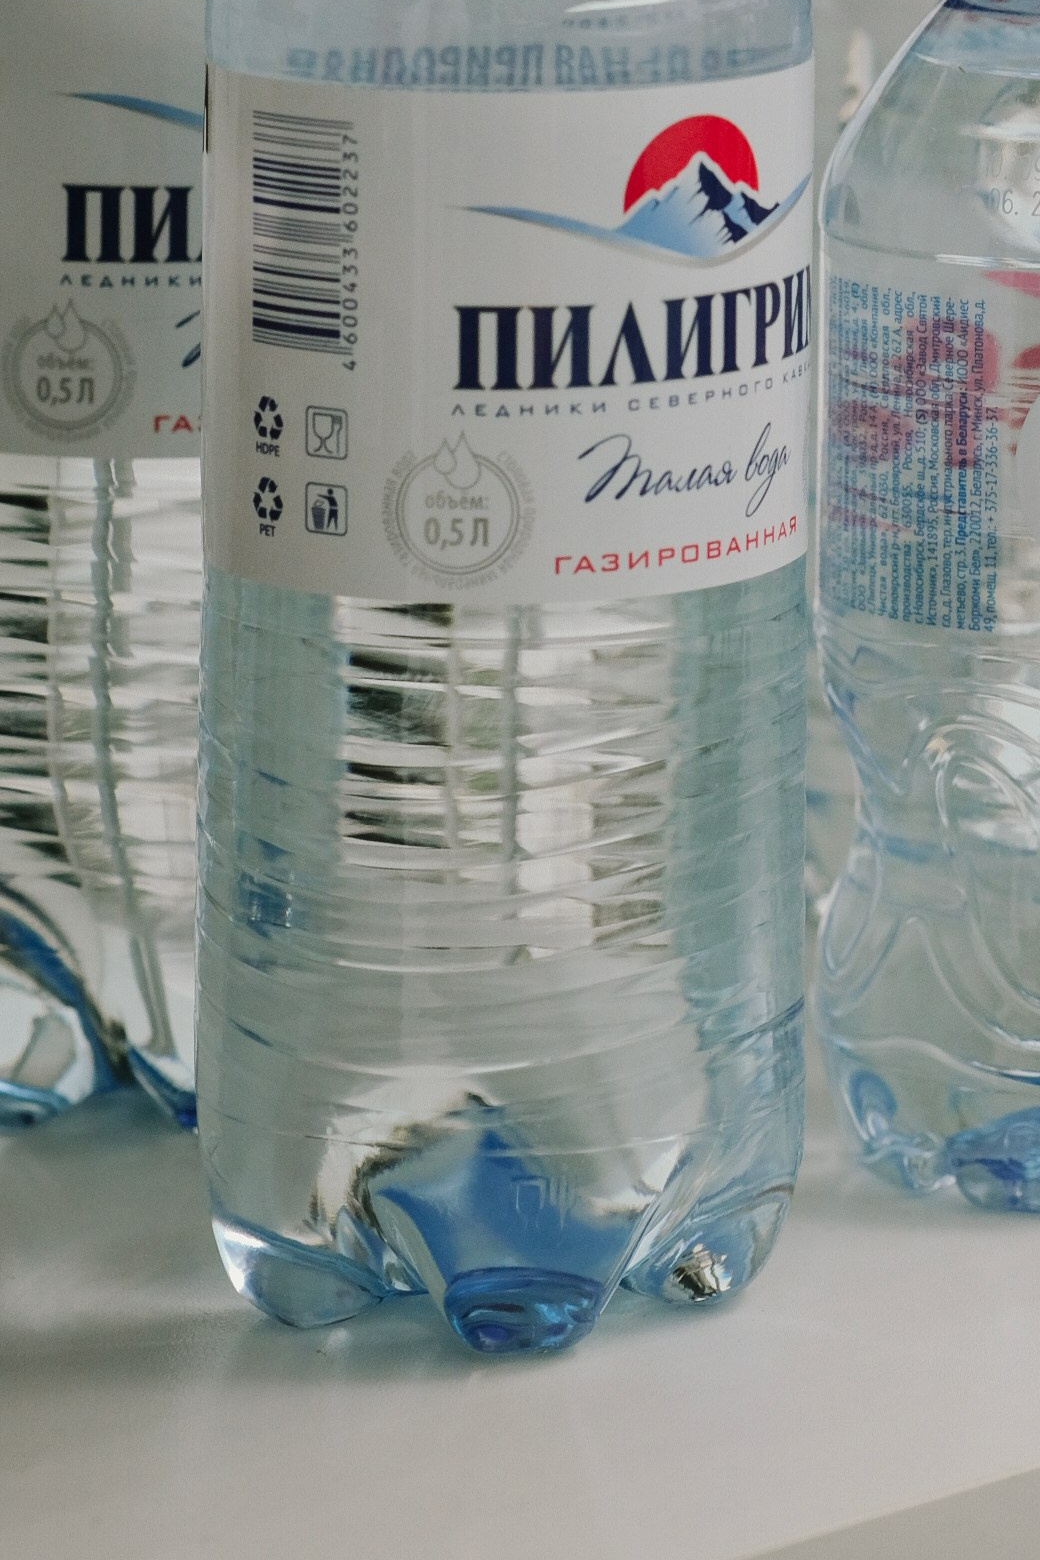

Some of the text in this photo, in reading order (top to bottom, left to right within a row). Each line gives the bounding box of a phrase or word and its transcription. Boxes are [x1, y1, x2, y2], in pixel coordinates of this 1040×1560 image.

[894, 289, 904, 324] адрес
[916, 294, 928, 334] Святой
[943, 296, 957, 334] Шере-
[916, 336, 929, 376] «Завод
[929, 296, 944, 373] Дмитровский
[971, 311, 985, 374] Платонова,
[450, 403, 607, 418] ЛЕДНИКИ
[628, 377, 774, 412] СЕВЕРНОГО
[915, 379, 926, 405] ООО
[944, 394, 956, 427] парка
[971, 393, 984, 432] Минск,
[915, 408, 928, 425] (S)
[928, 403, 940, 470] Московская
[956, 388, 970, 446] Беларуси:
[255, 440, 281, 458] HDPE
[915, 428, 927, 453] 510;
[970, 442, 985, 496] Беларусь,
[927, 472, 939, 514] Россия,
[955, 457, 968, 545] Представитель
[259, 523, 276, 537] PET
[423, 516, 465, 551] 0,5
[927, 516, 939, 561] 141895,
[970, 498, 983, 544] 220012,
[554, 514, 798, 575] ГАЗИРОВАННАЯ
[902, 540, 912, 622] производства:
[913, 539, 926, 615] Новосибирск,
[940, 551, 953, 596] Глазово,
[956, 580, 967, 629] метьево,
[968, 579, 983, 631] Боржоми
